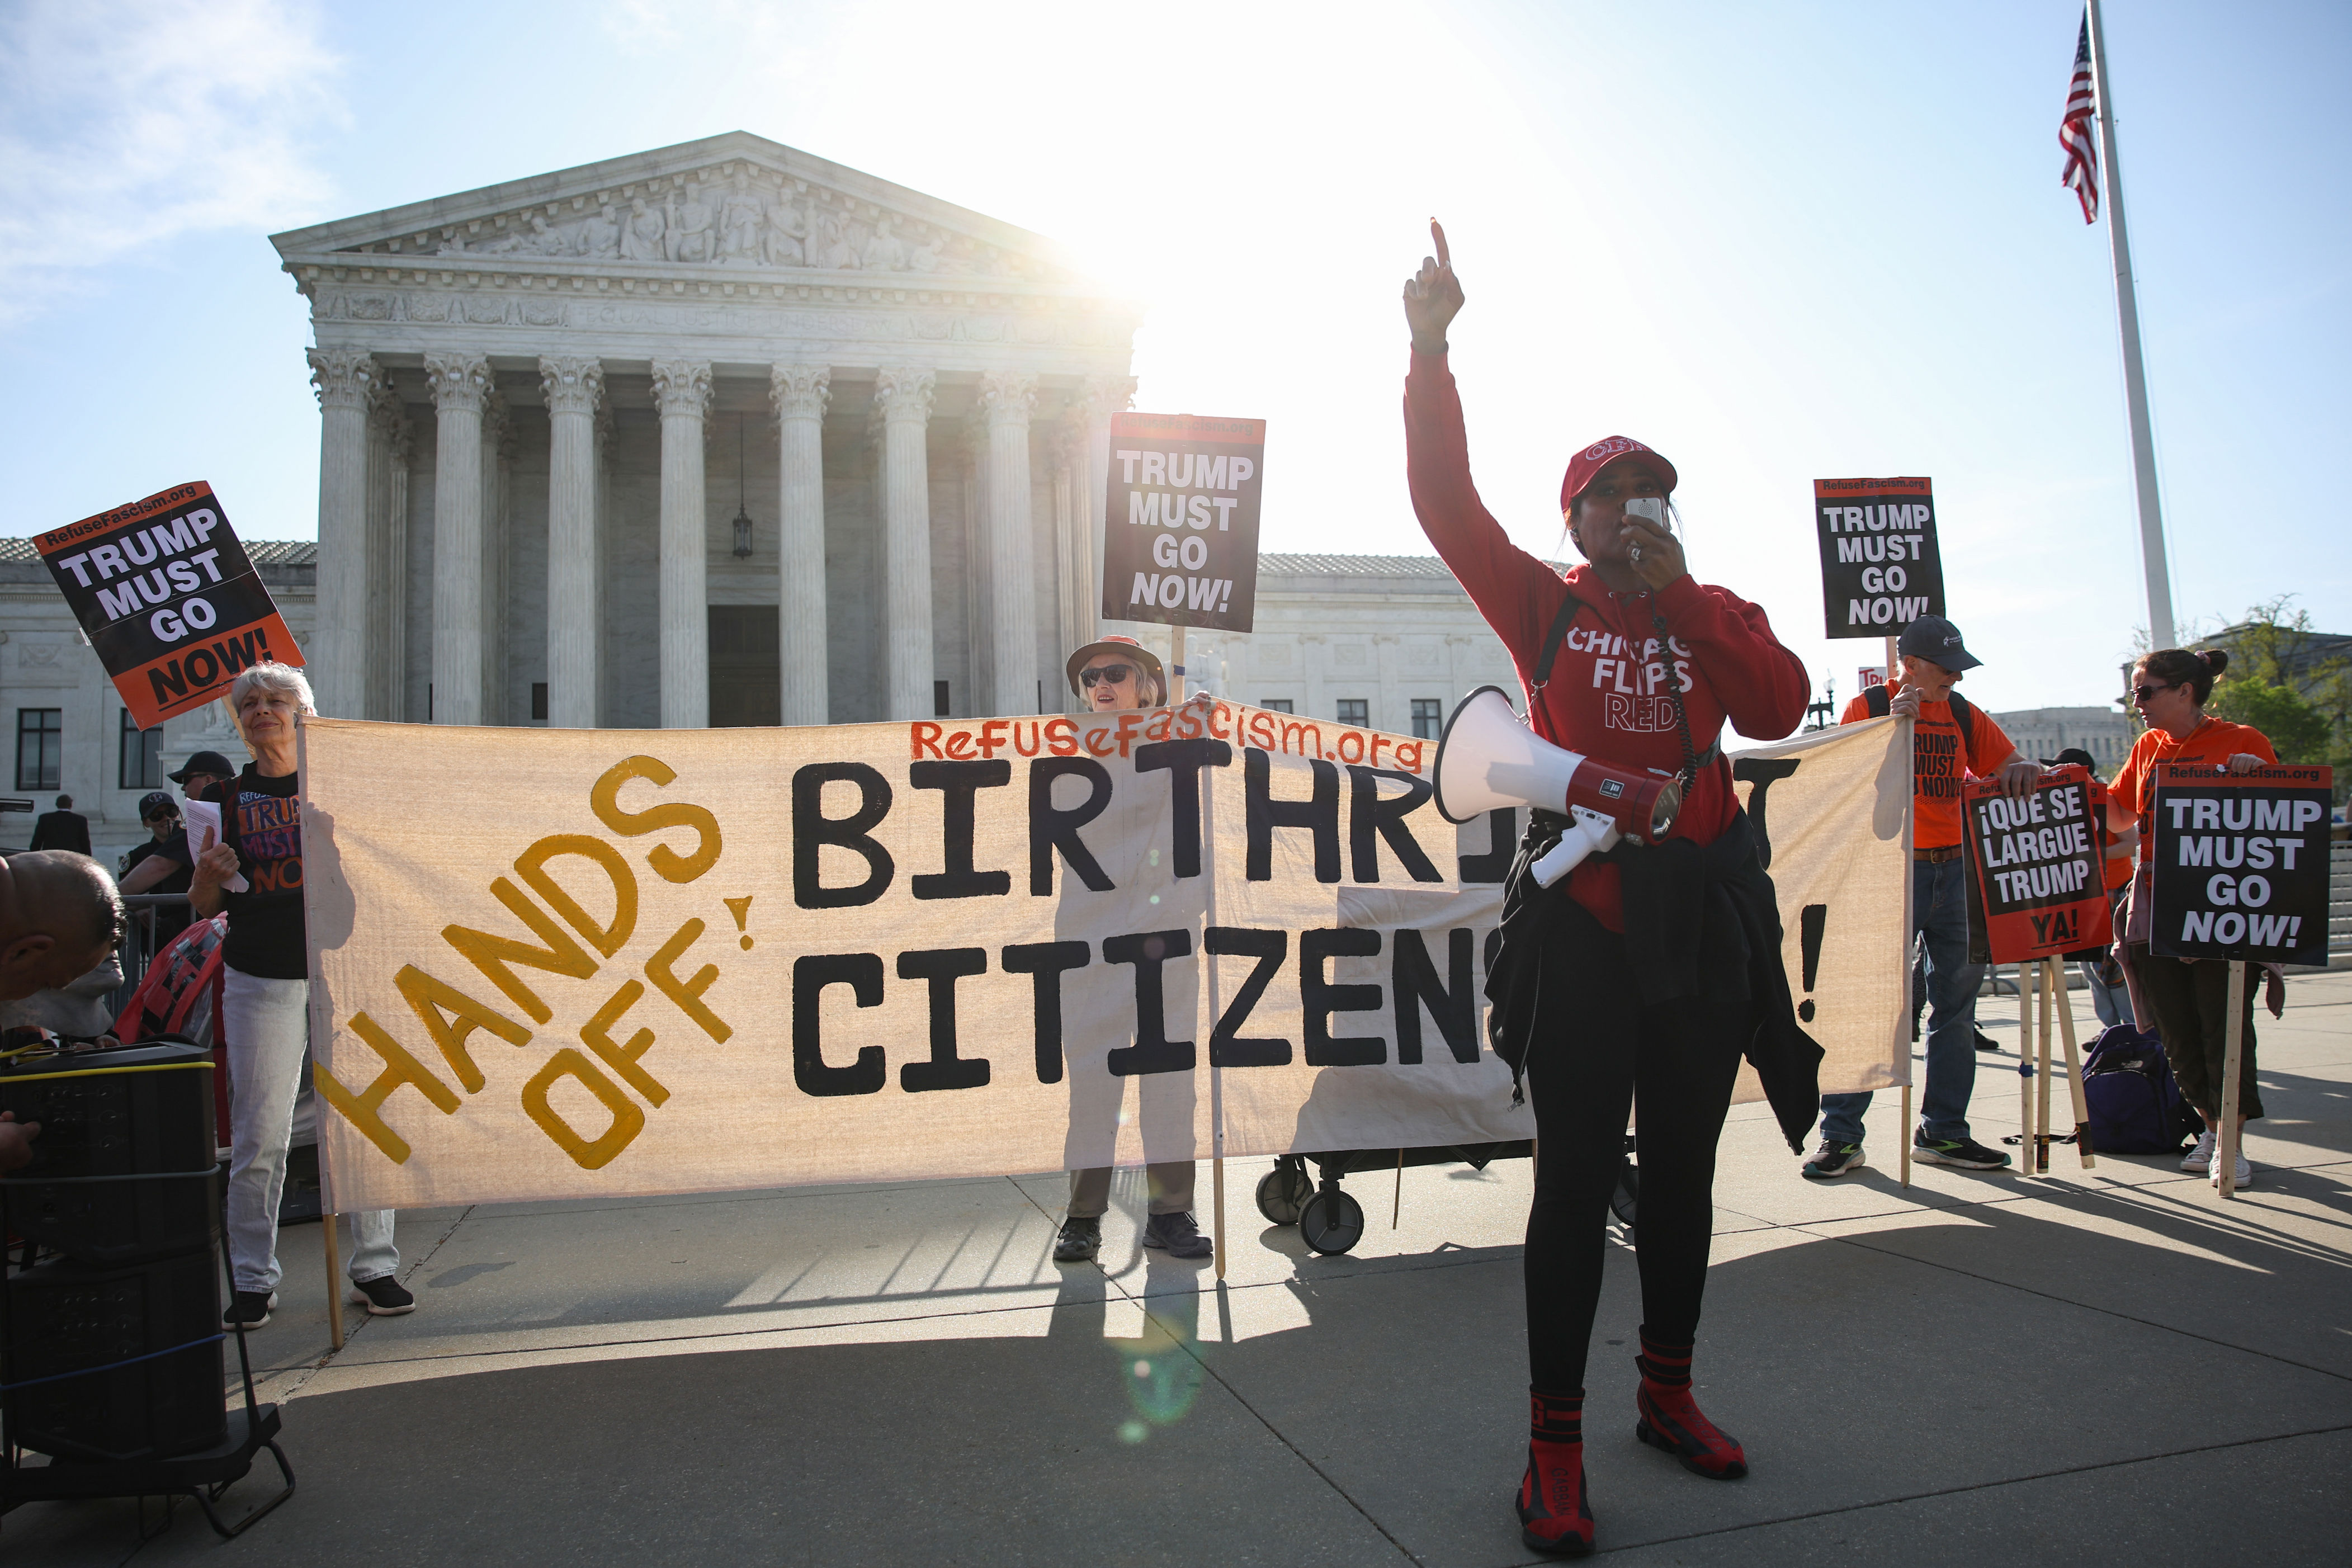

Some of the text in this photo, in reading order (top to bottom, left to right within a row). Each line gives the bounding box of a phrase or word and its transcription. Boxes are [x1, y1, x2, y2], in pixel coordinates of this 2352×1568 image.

[585, 306, 893, 332] EQUAL JUSTICE UNDER LAW
[1120, 414, 1254, 436] RefuseFascism.org
[1116, 449, 1254, 490] TRUMP
[1823, 479, 1925, 490] RefuseFascism.org
[44, 483, 197, 547] RefuseFascism.org
[1128, 491, 1238, 531] MUST
[1822, 504, 1930, 532] TRUMP
[58, 508, 219, 588] TRUMP
[1153, 533, 1208, 570] GO
[1837, 535, 1924, 563] MUST
[95, 548, 223, 621] MUST
[1130, 572, 1232, 613] NOW!
[1861, 565, 1907, 594] GO
[150, 597, 217, 643] GO
[1848, 596, 1929, 625] NOW!
[147, 627, 273, 706] NOW!
[1592, 658, 1693, 696] FLIPS
[1605, 692, 1679, 733] RED
[1914, 733, 1958, 755] RUMP
[1978, 786, 2082, 835] ¡QUE SE
[2165, 798, 2322, 832] TRUMP
[240, 826, 296, 860] MUST
[1982, 821, 2089, 868] LARGUE
[2179, 835, 2304, 870] MUST
[1994, 859, 2089, 904] TRUMP
[2207, 873, 2271, 908] GO
[2030, 908, 2079, 944] YA!
[2181, 910, 2302, 948] NOW!
[313, 754, 722, 1165] HANDS
[522, 895, 754, 1170] OFF!
